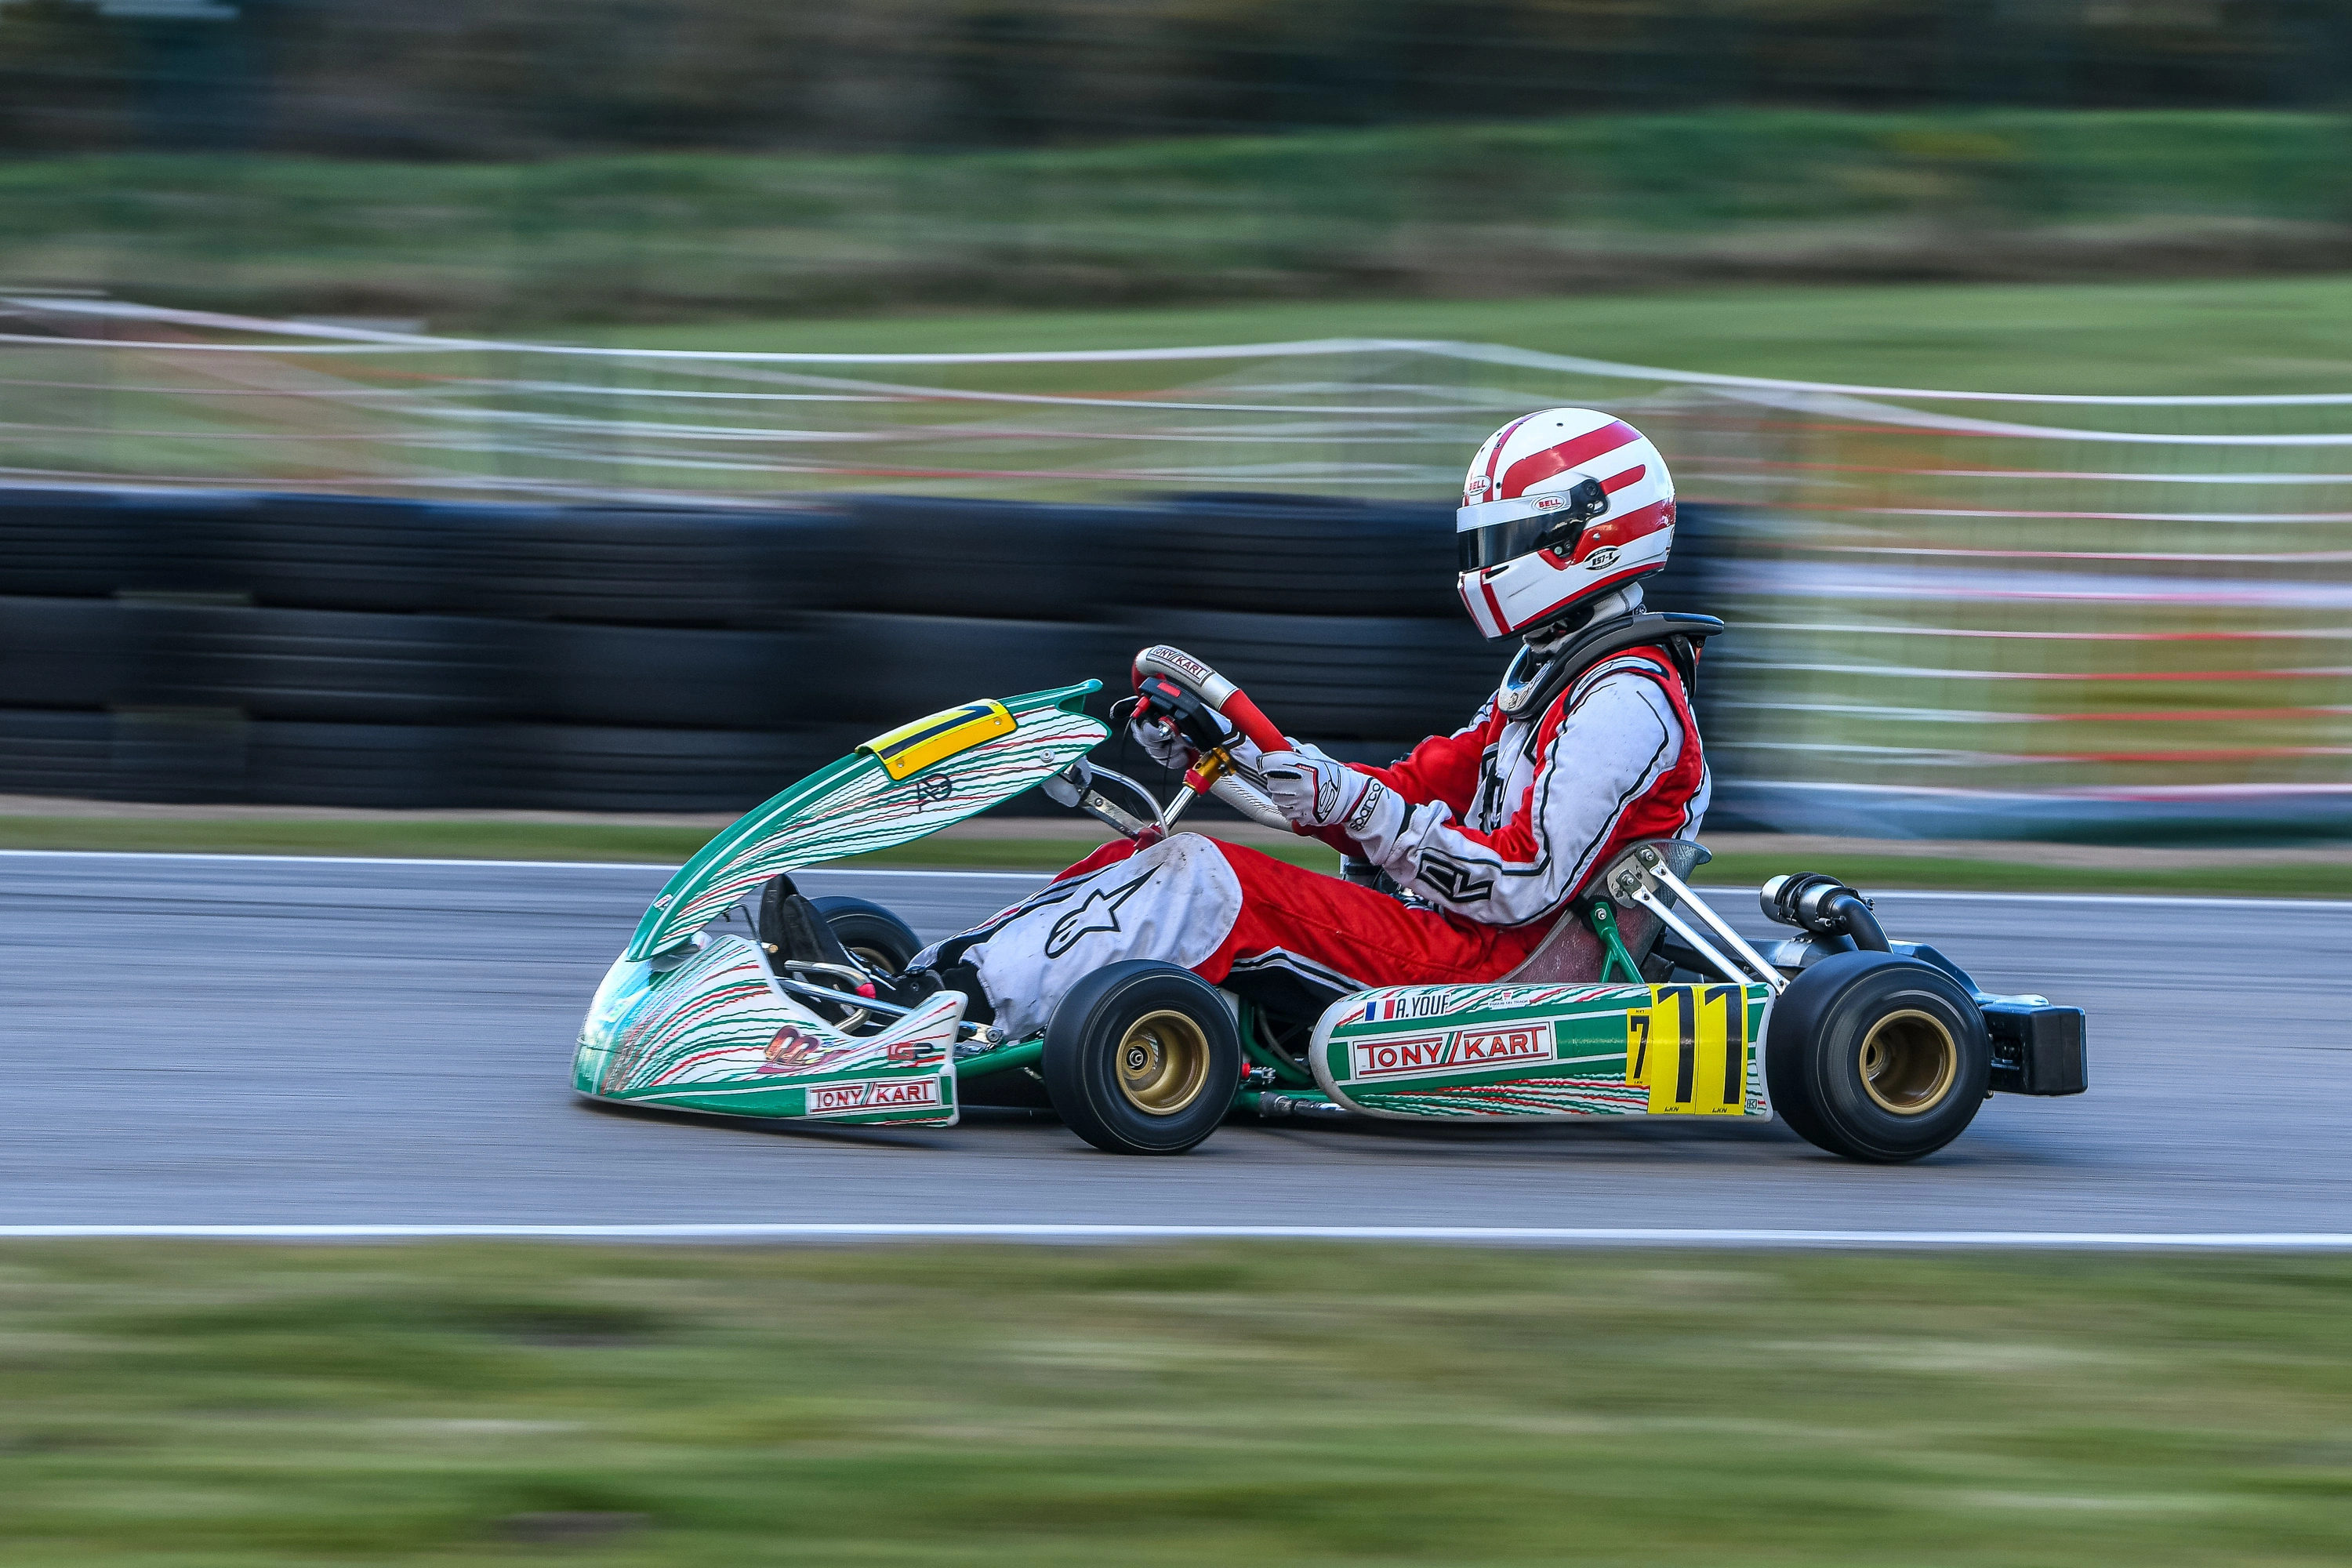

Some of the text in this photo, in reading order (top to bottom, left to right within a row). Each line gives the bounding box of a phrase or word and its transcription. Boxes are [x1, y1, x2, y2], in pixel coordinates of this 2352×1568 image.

[1538, 499, 1561, 508] BELL
[1176, 656, 1204, 675] KART
[1349, 782, 1381, 832] sparco
[1358, 1026, 1546, 1069] TONY KART
[1631, 985, 1742, 1105] 7 11
[877, 1083, 931, 1102] KART
